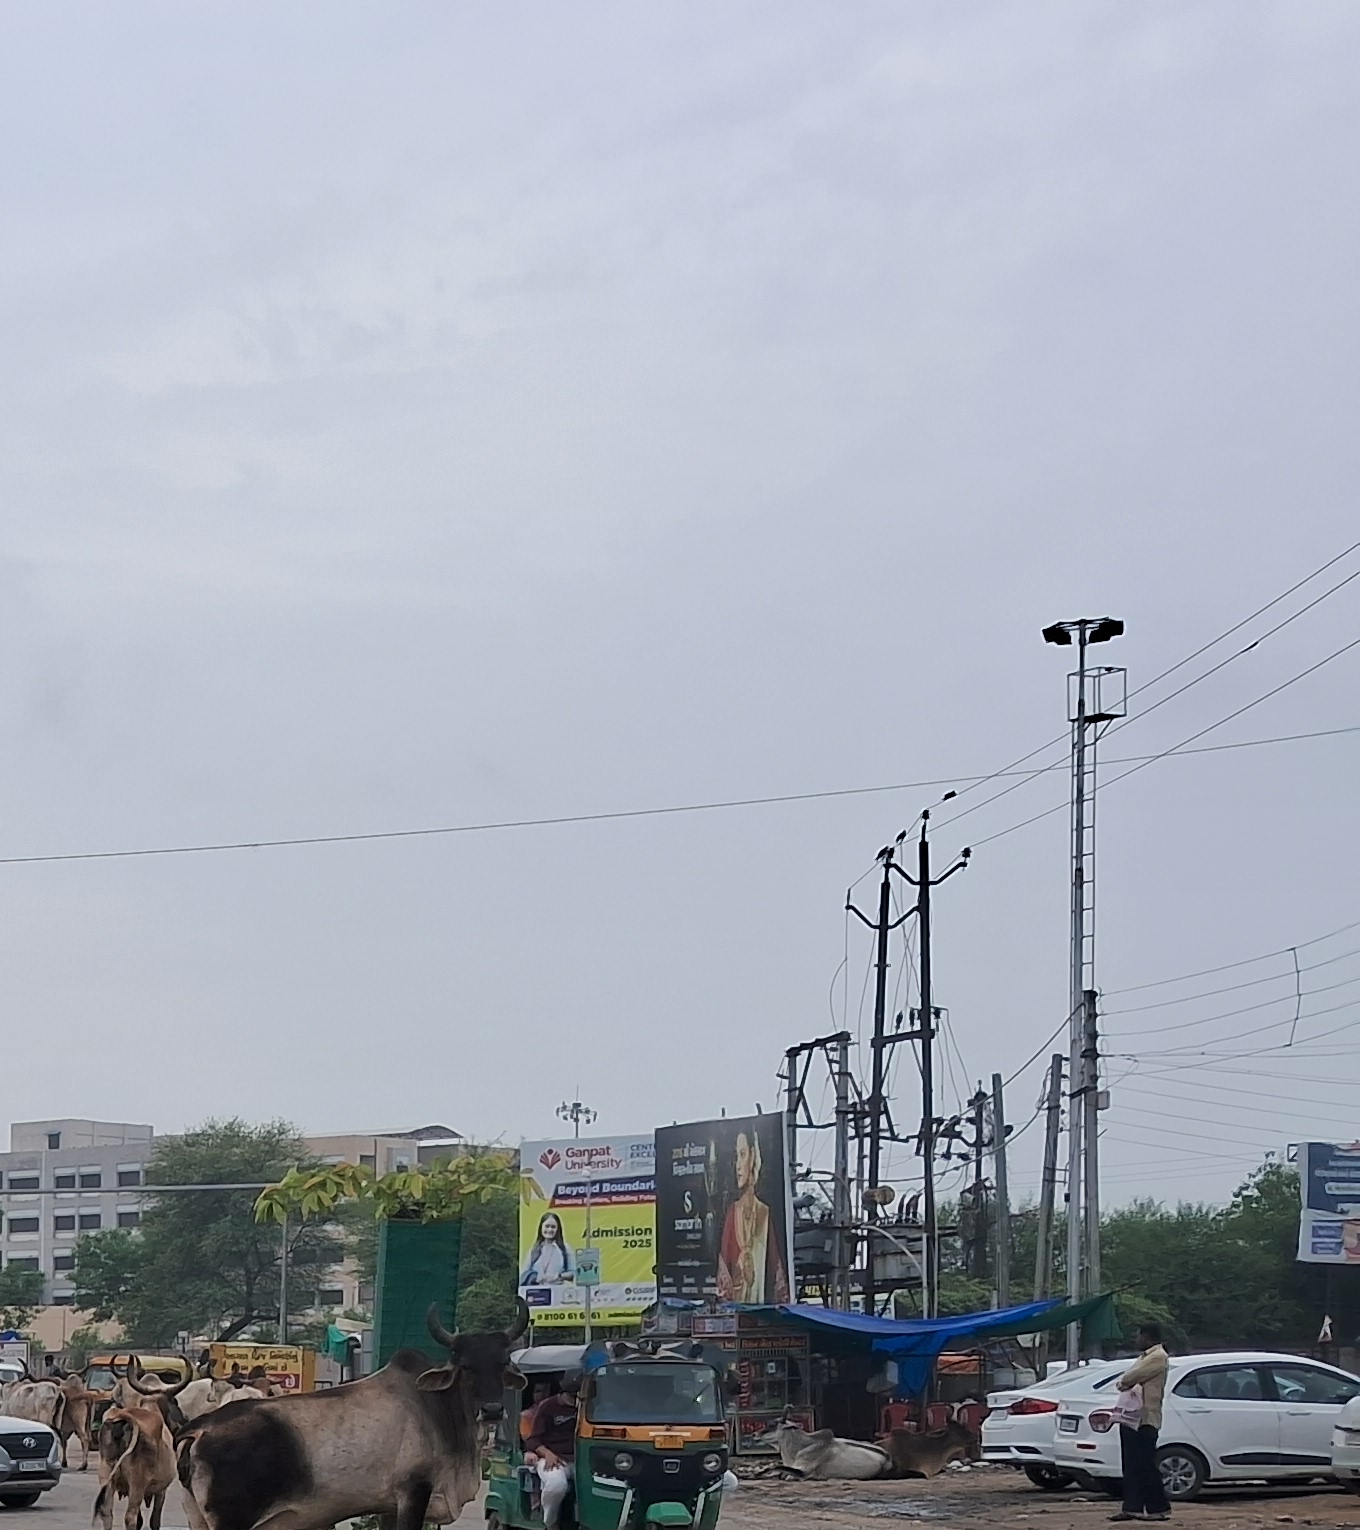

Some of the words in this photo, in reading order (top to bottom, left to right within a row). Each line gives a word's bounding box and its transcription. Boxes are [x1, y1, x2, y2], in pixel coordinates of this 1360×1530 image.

[565, 1145, 612, 1160] Ganpat
[630, 1143, 655, 1151] CENT
[622, 1238, 652, 1249] 2025
